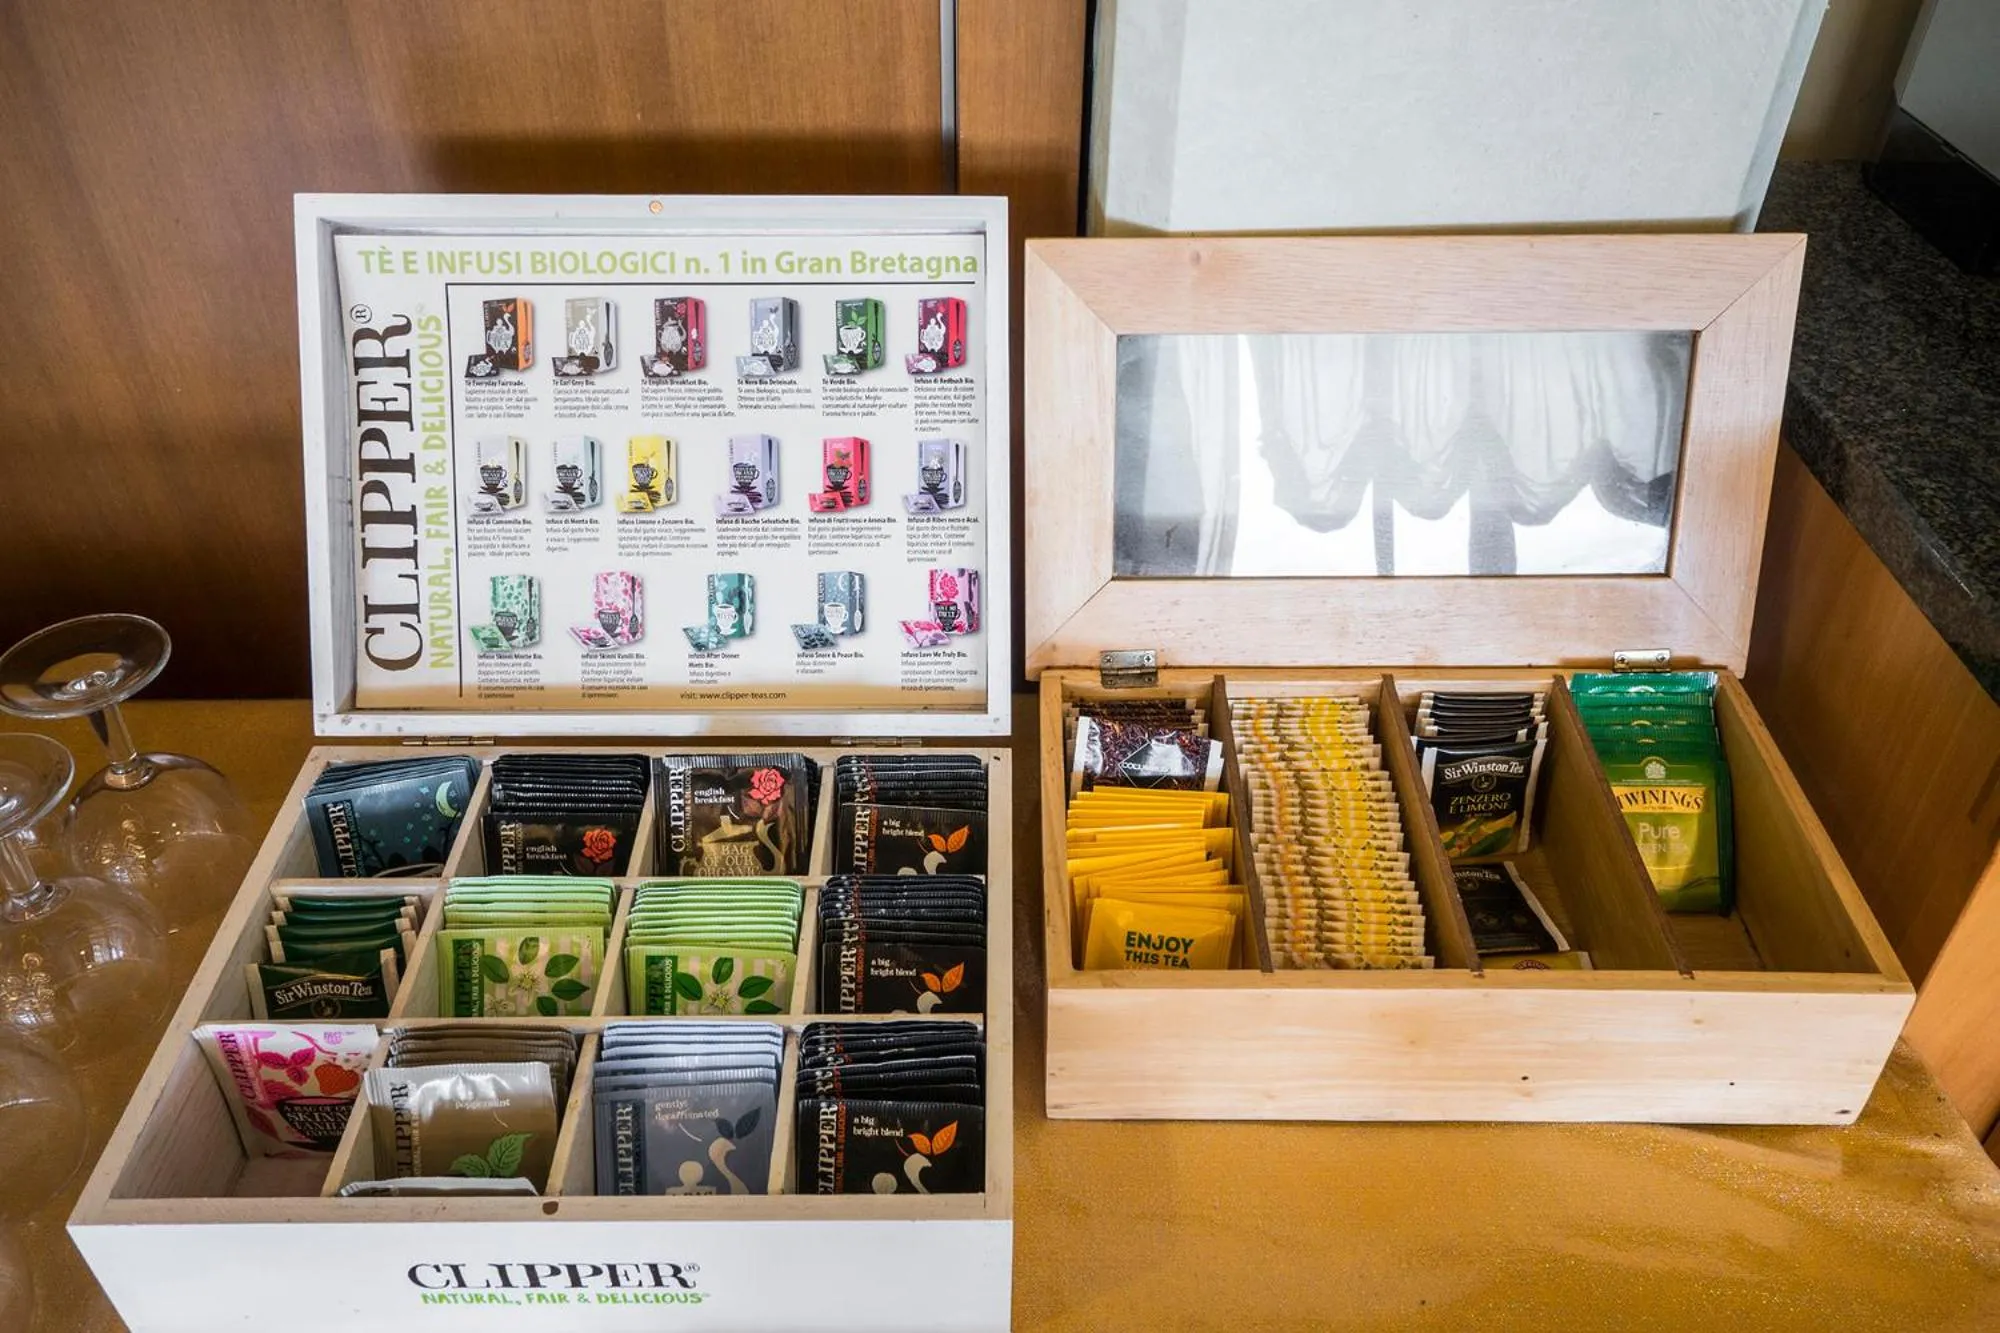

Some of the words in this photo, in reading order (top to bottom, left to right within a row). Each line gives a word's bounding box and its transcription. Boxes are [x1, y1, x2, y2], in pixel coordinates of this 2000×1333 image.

[358, 246, 395, 274] TÈ
[403, 251, 418, 274] E
[427, 251, 522, 275] INFUSI
[530, 251, 675, 275] BIOLOGICI
[684, 257, 709, 274] n.
[718, 252, 730, 274] 1
[741, 251, 767, 274] in
[775, 251, 842, 275] Gran
[850, 251, 978, 279] Bretagna
[417, 314, 447, 450] DELICIOUS
[649, 378, 669, 386] English
[670, 378, 697, 386] Breakfast
[423, 459, 447, 476] &
[424, 486, 451, 538] FAIR
[427, 547, 454, 669] NATURAL,
[680, 692, 697, 700] visit:
[700, 692, 786, 700] www.clipper-teas.com
[1444, 767, 1462, 780] Sir
[1461, 762, 1508, 774] Winston
[1508, 762, 1524, 774] Tea
[694, 788, 725, 796] english
[1450, 792, 1512, 805] ZENZERO
[694, 796, 735, 804] breakfast
[670, 767, 686, 852] CLIPPER
[1460, 802, 1510, 812] LIMONE
[889, 818, 900, 827] big
[882, 827, 904, 836] bright
[905, 828, 924, 836] blend
[1639, 822, 1680, 839] Pure
[854, 807, 870, 874] LIPPER
[501, 822, 516, 875] PPER
[526, 845, 557, 853] english
[722, 844, 749, 856] BAG
[726, 855, 754, 866] OUR
[1126, 931, 1194, 954] ENJOY
[877, 958, 890, 967] big
[1125, 950, 1159, 964] THIS
[1164, 954, 1190, 968] TEA
[664, 959, 672, 993] DELICIOUS
[870, 968, 894, 977] bright
[896, 968, 916, 976] blend
[840, 946, 856, 1013] IPPER
[275, 989, 294, 1005] Sir
[292, 982, 350, 999] Winston
[350, 982, 373, 996] Tea
[219, 1032, 256, 1099] CLIPPER
[655, 1100, 687, 1111] gently
[655, 1108, 720, 1120] decaffeinated
[861, 1116, 875, 1126] big
[853, 1126, 878, 1137] bright
[880, 1127, 904, 1137] blend
[421, 1292, 521, 1305] NATURAL,
[526, 1292, 569, 1304] FAIR
[578, 1292, 592, 1304] &
